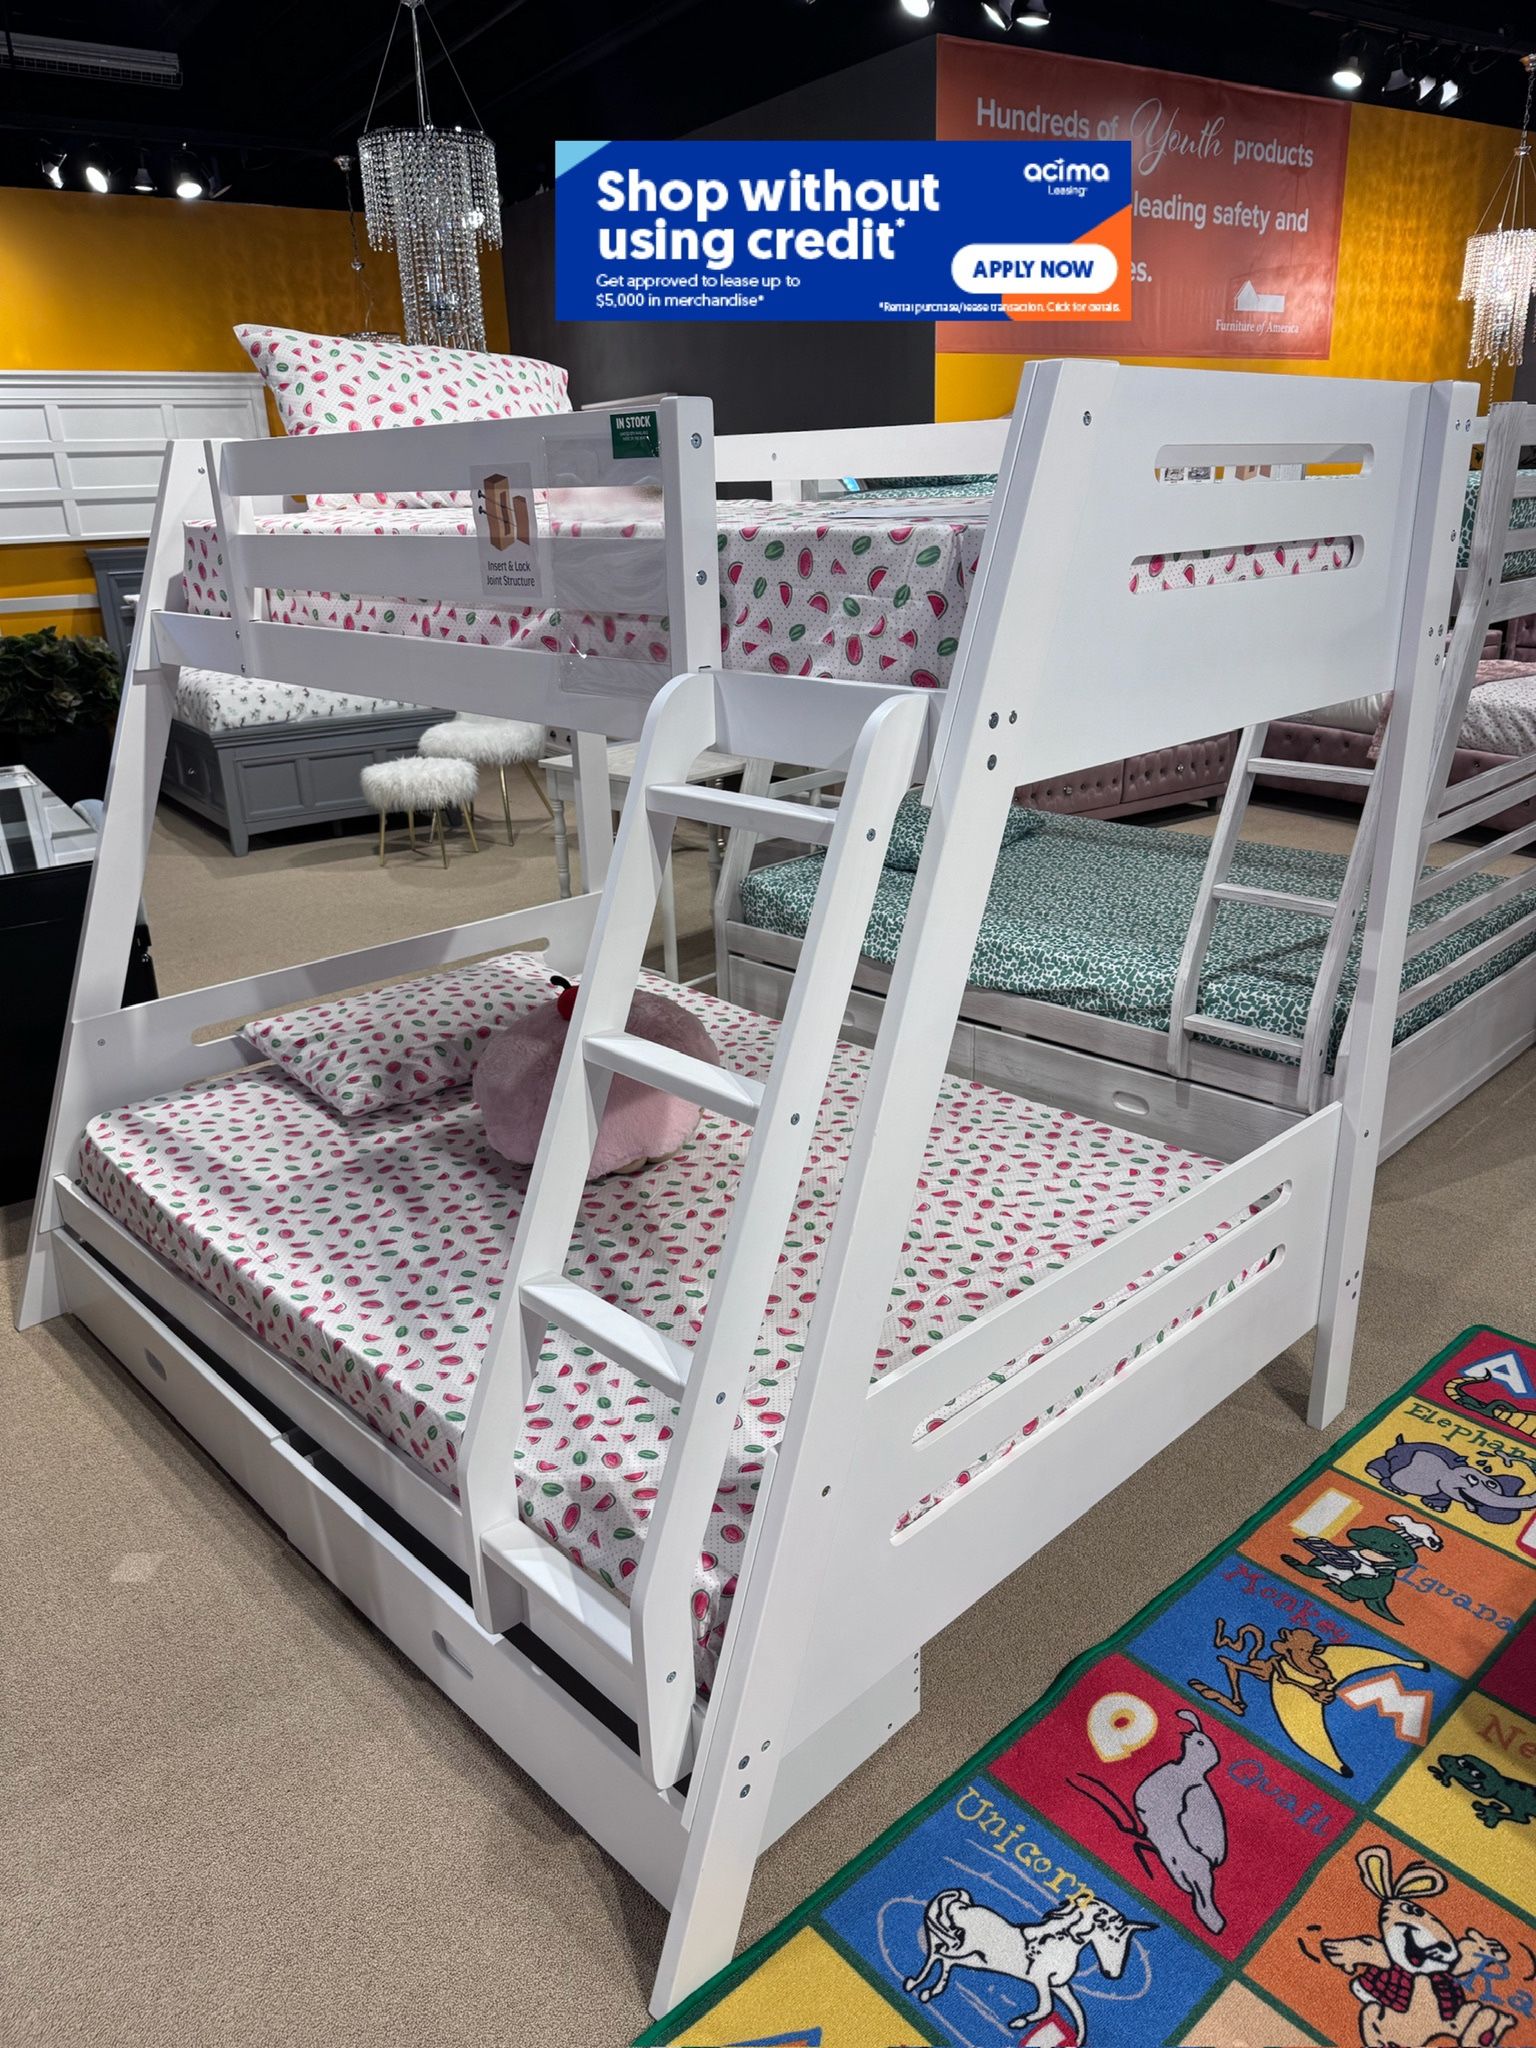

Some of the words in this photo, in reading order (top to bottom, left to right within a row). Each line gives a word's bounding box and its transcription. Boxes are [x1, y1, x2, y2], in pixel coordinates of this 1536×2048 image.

[976, 96, 1090, 139] Hundreds
[1097, 115, 1120, 141] of
[1130, 97, 1225, 176] Youth
[1233, 138, 1314, 167] products
[1133, 190, 1207, 229] leading
[1213, 201, 1271, 235] safety
[1275, 208, 1309, 232] and
[1215, 319, 1255, 332] Furniture
[1256, 319, 1267, 336] of
[1267, 321, 1300, 334] America
[616, 417, 625, 429] IN
[626, 416, 651, 428] STOCK
[487, 560, 507, 571] Insert
[508, 560, 514, 571] &
[515, 560, 531, 571] Lock
[487, 575, 502, 586] Joint
[503, 575, 535, 586] Structure
[1223, 1563, 1350, 1644] Monkey
[1396, 1563, 1518, 1632] Iguana
[1227, 1758, 1334, 1837] Quail
[955, 1786, 1096, 1909] Unicorn
